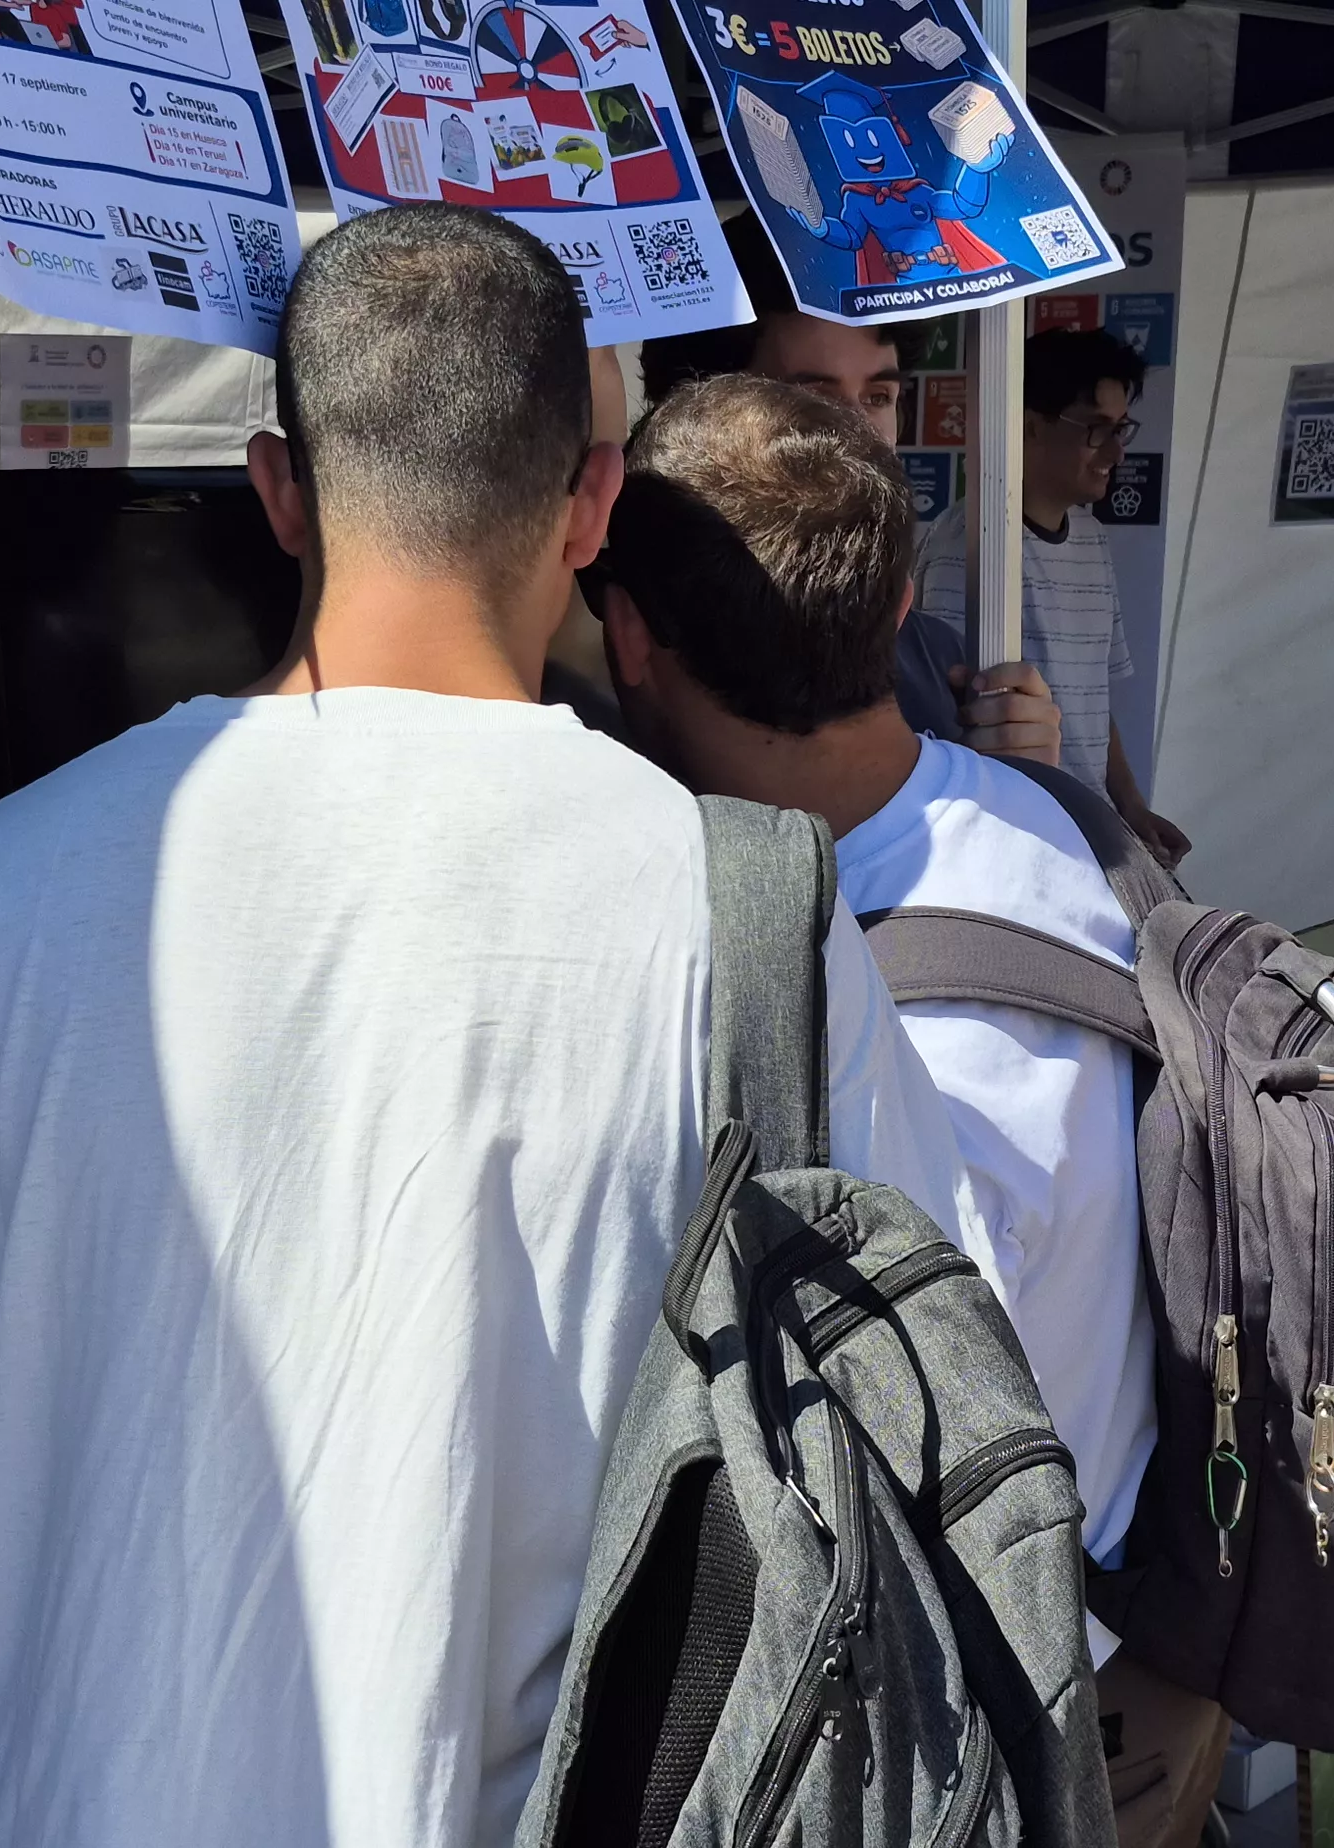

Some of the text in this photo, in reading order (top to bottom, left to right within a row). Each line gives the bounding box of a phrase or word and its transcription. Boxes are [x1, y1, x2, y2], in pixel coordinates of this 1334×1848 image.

[104, 8, 188, 44] Punto de encuentro
[705, 6, 756, 55] 3€
[770, 21, 800, 60] 5
[796, 26, 892, 66] BOLETOS
[2, 71, 17, 85] 17
[20, 76, 88, 97] septiembre
[419, 74, 454, 92] 100€
[167, 91, 218, 114] Campus
[954, 99, 978, 117] 1525
[4, 115, 13, 128] h
[21, 119, 56, 135] 15:00
[57, 123, 67, 136] h
[159, 104, 238, 131] universitario
[750, 106, 773, 127] 1525
[167, 127, 179, 138] 15
[180, 131, 192, 141] en
[185, 147, 197, 156] en
[198, 146, 227, 161] Teruel
[105, 205, 125, 238] GRUPO
[117, 206, 207, 245] LACASA
[854, 270, 1015, 312] ¡PARTICIPA Y COLABORA!
